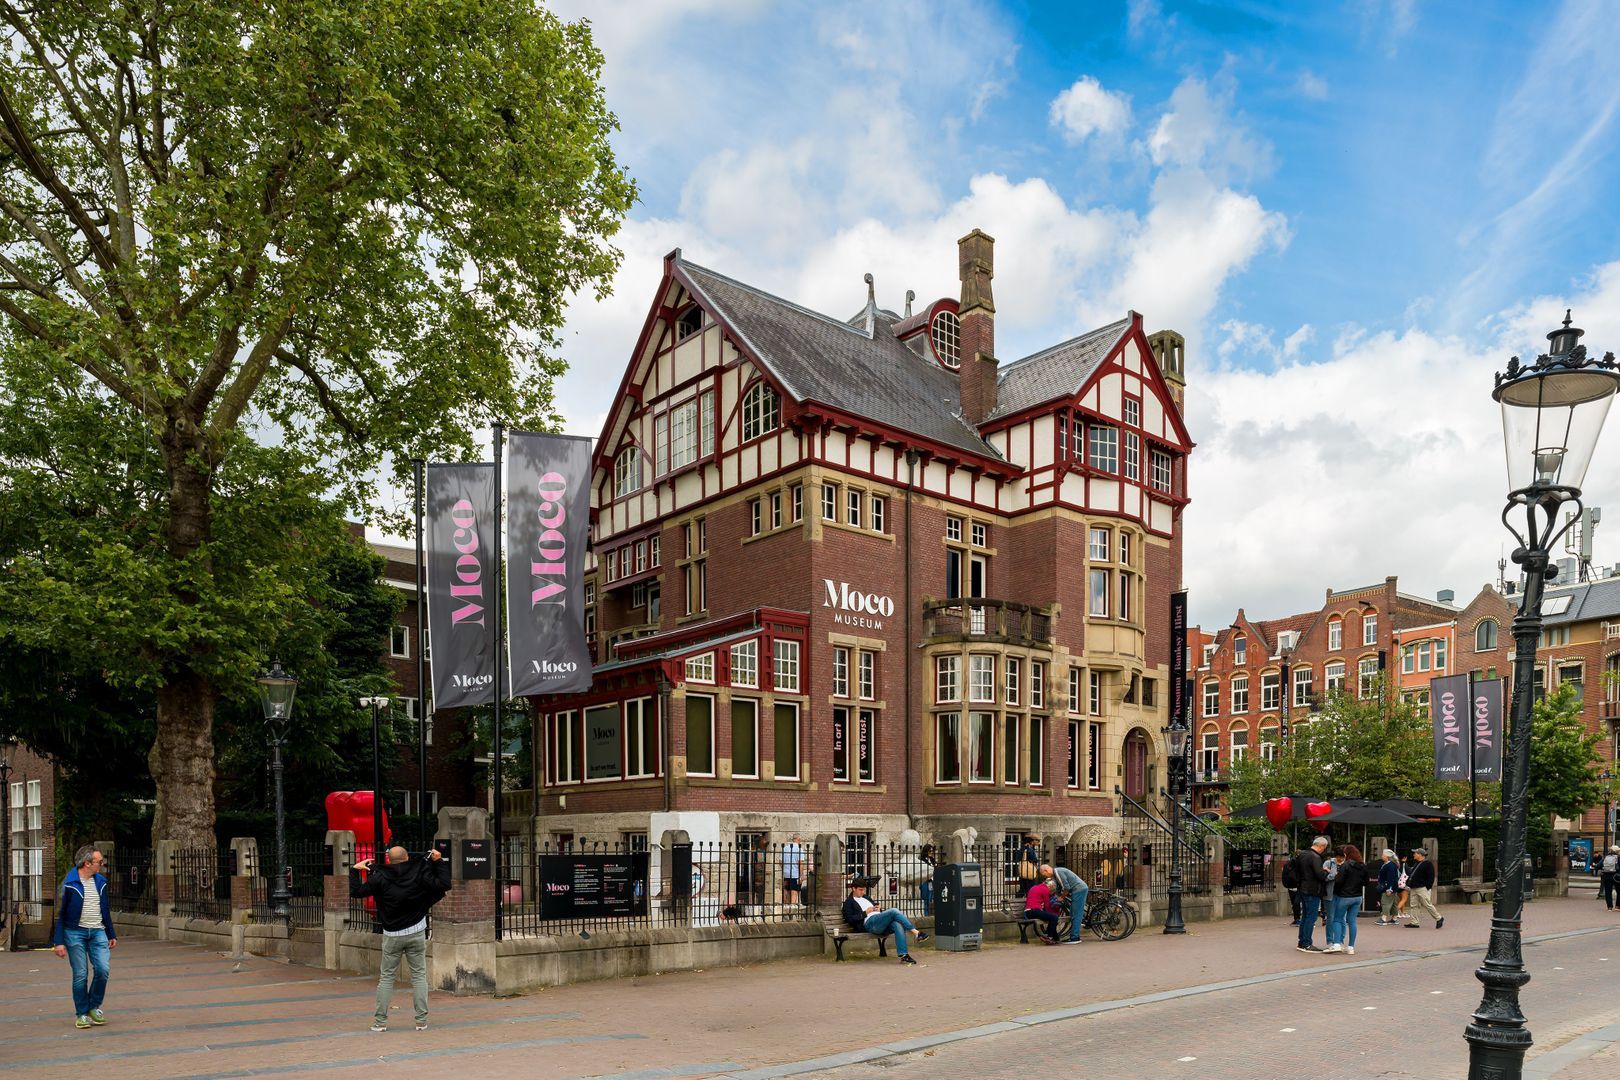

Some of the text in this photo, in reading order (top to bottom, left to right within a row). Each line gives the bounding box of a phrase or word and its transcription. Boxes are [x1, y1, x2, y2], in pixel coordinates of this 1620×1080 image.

[531, 471, 567, 613] Moco
[450, 499, 485, 631] Moco
[823, 578, 895, 617] Moco
[834, 613, 882, 630] MUSEUM
[1174, 605, 1182, 629] Hirst
[1174, 637, 1183, 670] Banksy
[531, 659, 577, 674] Moco
[452, 674, 493, 687] Moco
[1174, 677, 1182, 715] Kusama
[593, 727, 615, 740] Moco
[834, 722, 842, 739] art
[860, 744, 867, 760] we
[546, 883, 570, 892] Moco
